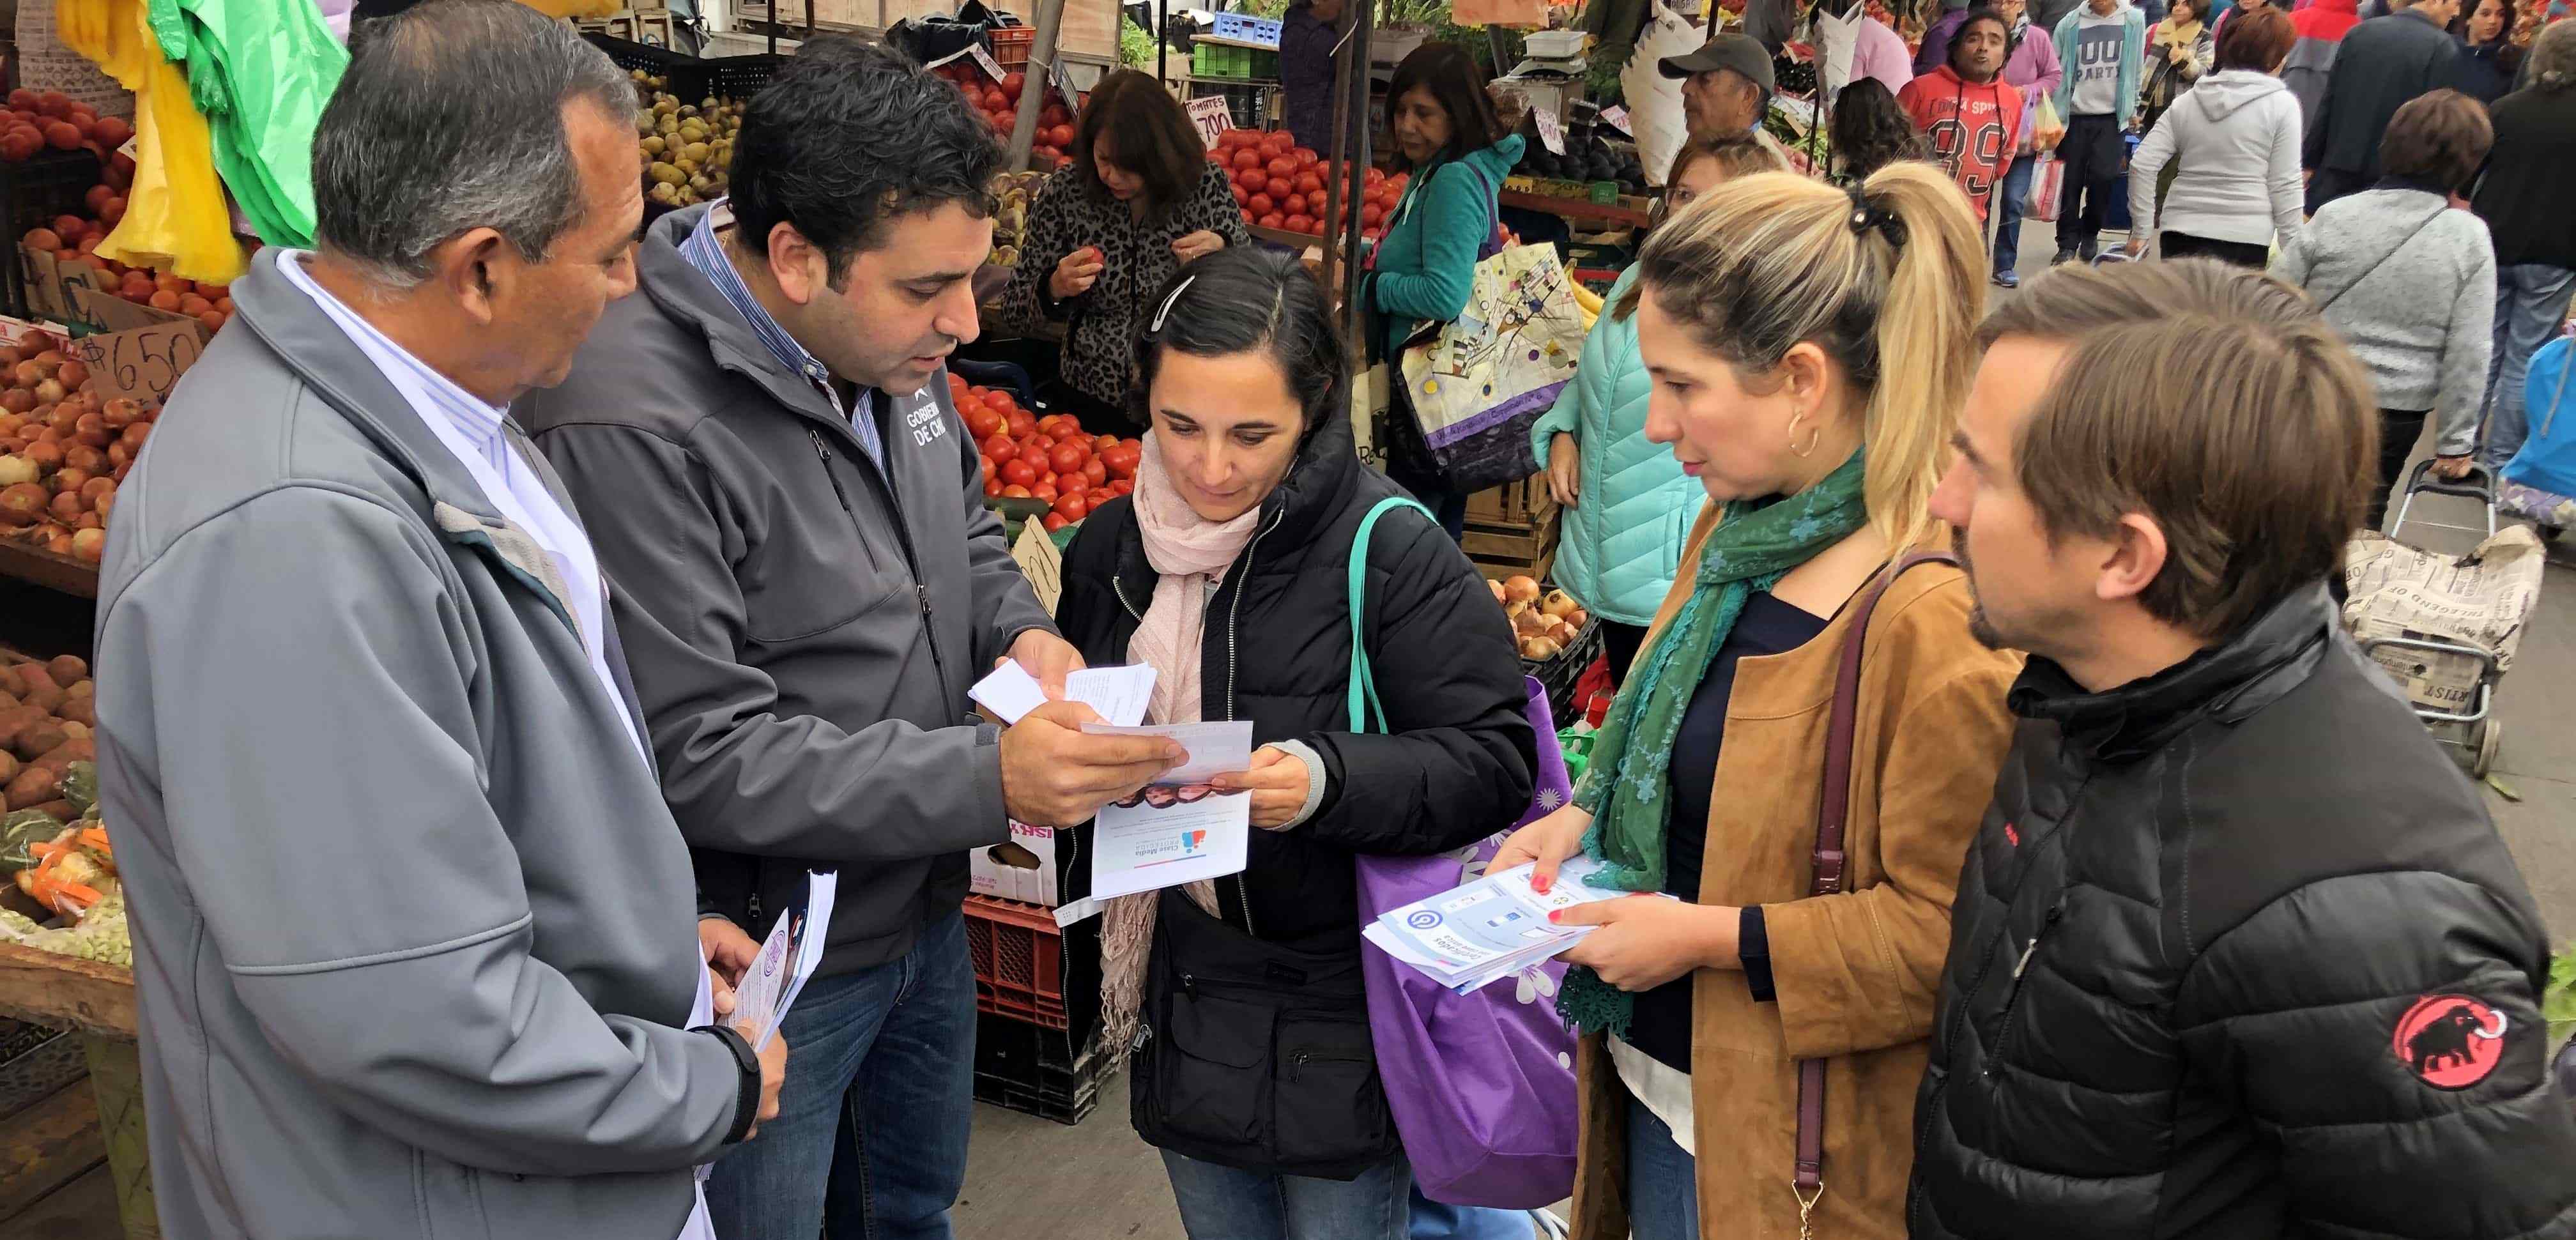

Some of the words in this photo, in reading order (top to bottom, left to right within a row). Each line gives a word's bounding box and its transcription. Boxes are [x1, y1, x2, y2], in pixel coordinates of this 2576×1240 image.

[1196, 112, 1231, 142] 700
[81, 332, 195, 392] $650
[913, 425, 933, 447] DE
